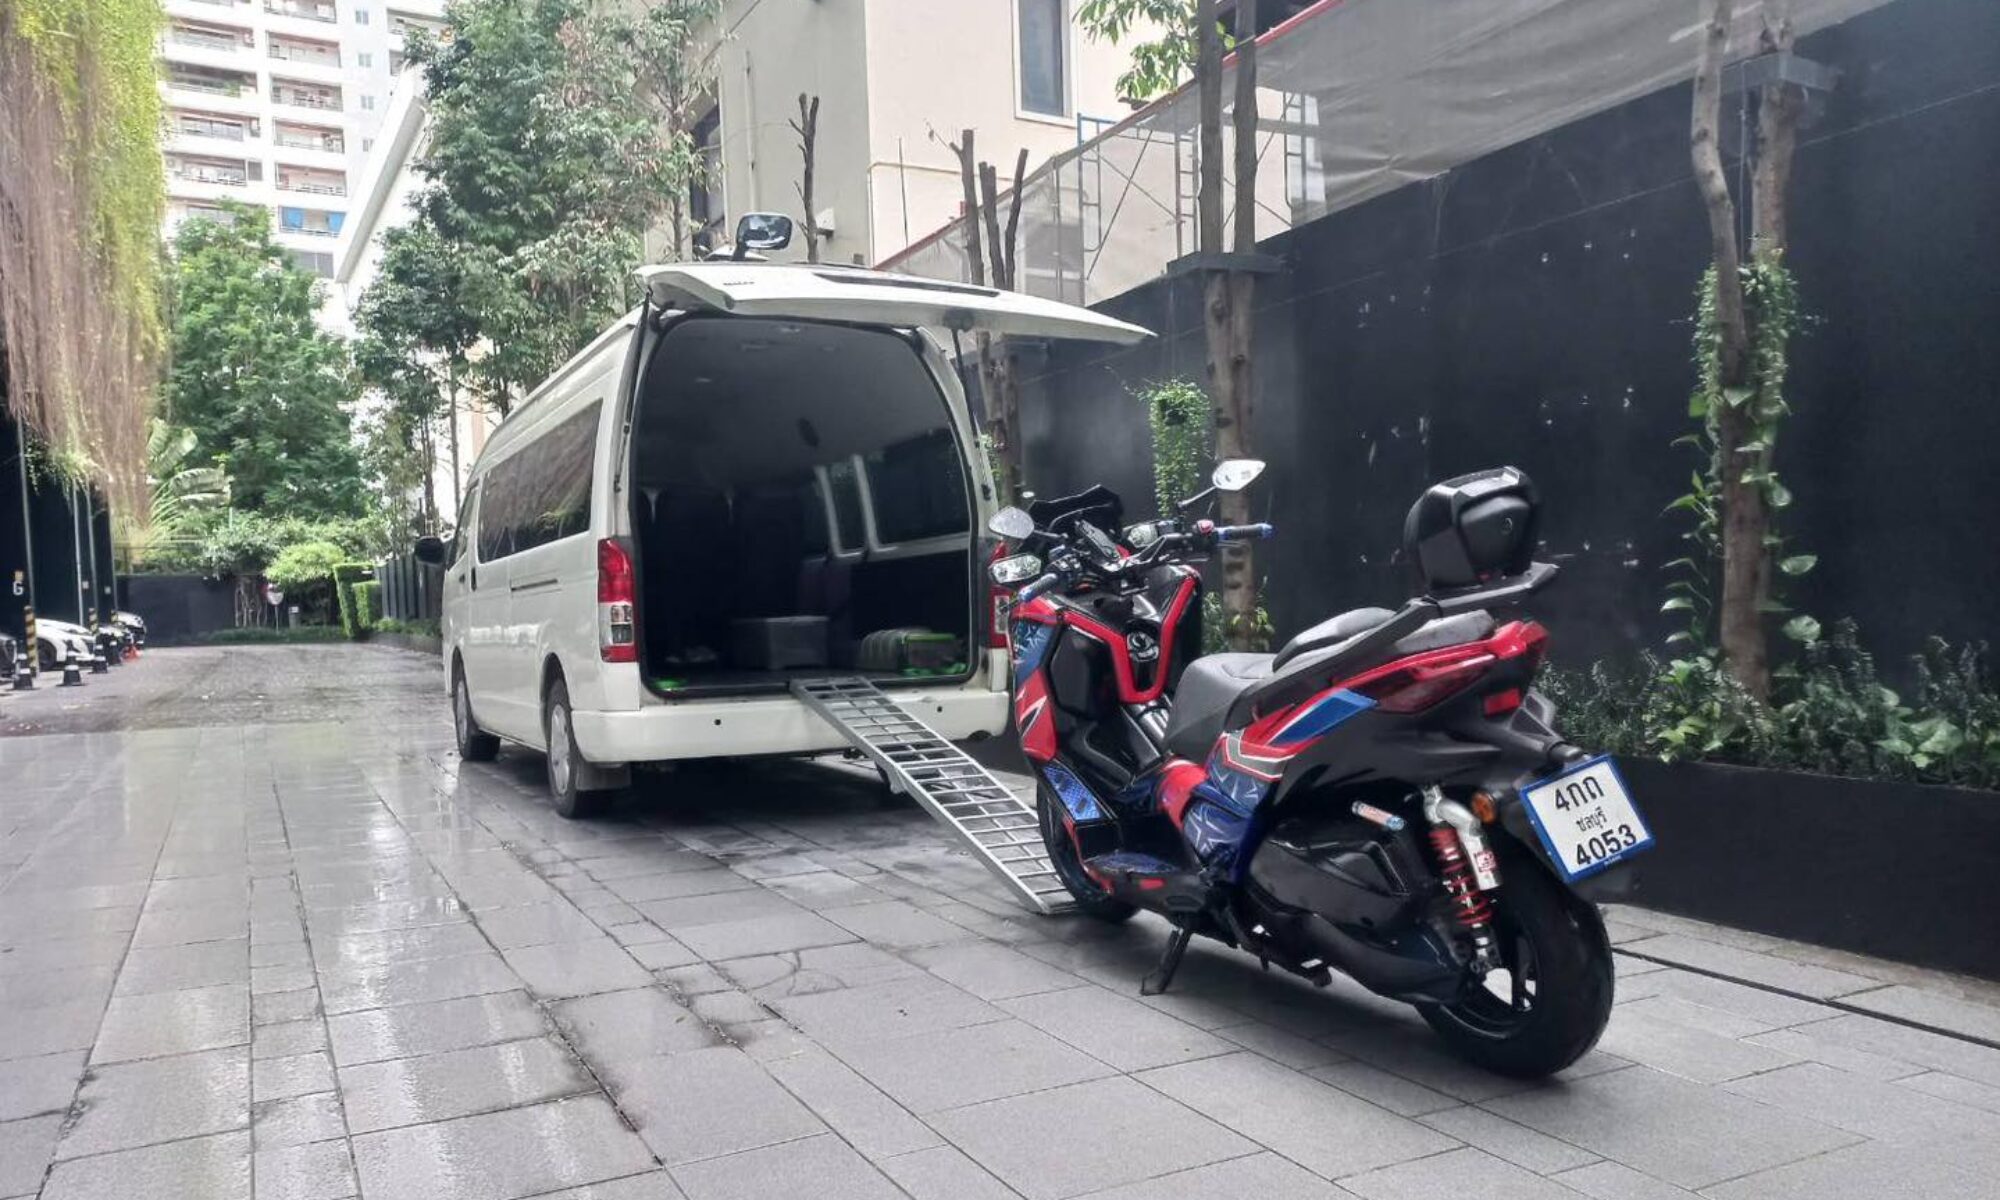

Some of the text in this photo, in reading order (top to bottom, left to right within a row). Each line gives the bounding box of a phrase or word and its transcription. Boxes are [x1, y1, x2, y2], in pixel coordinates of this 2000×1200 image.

[1556, 776, 1604, 812] 4กถ
[1576, 806, 1607, 832] ชลบุรี
[1577, 824, 1637, 866] 4053
